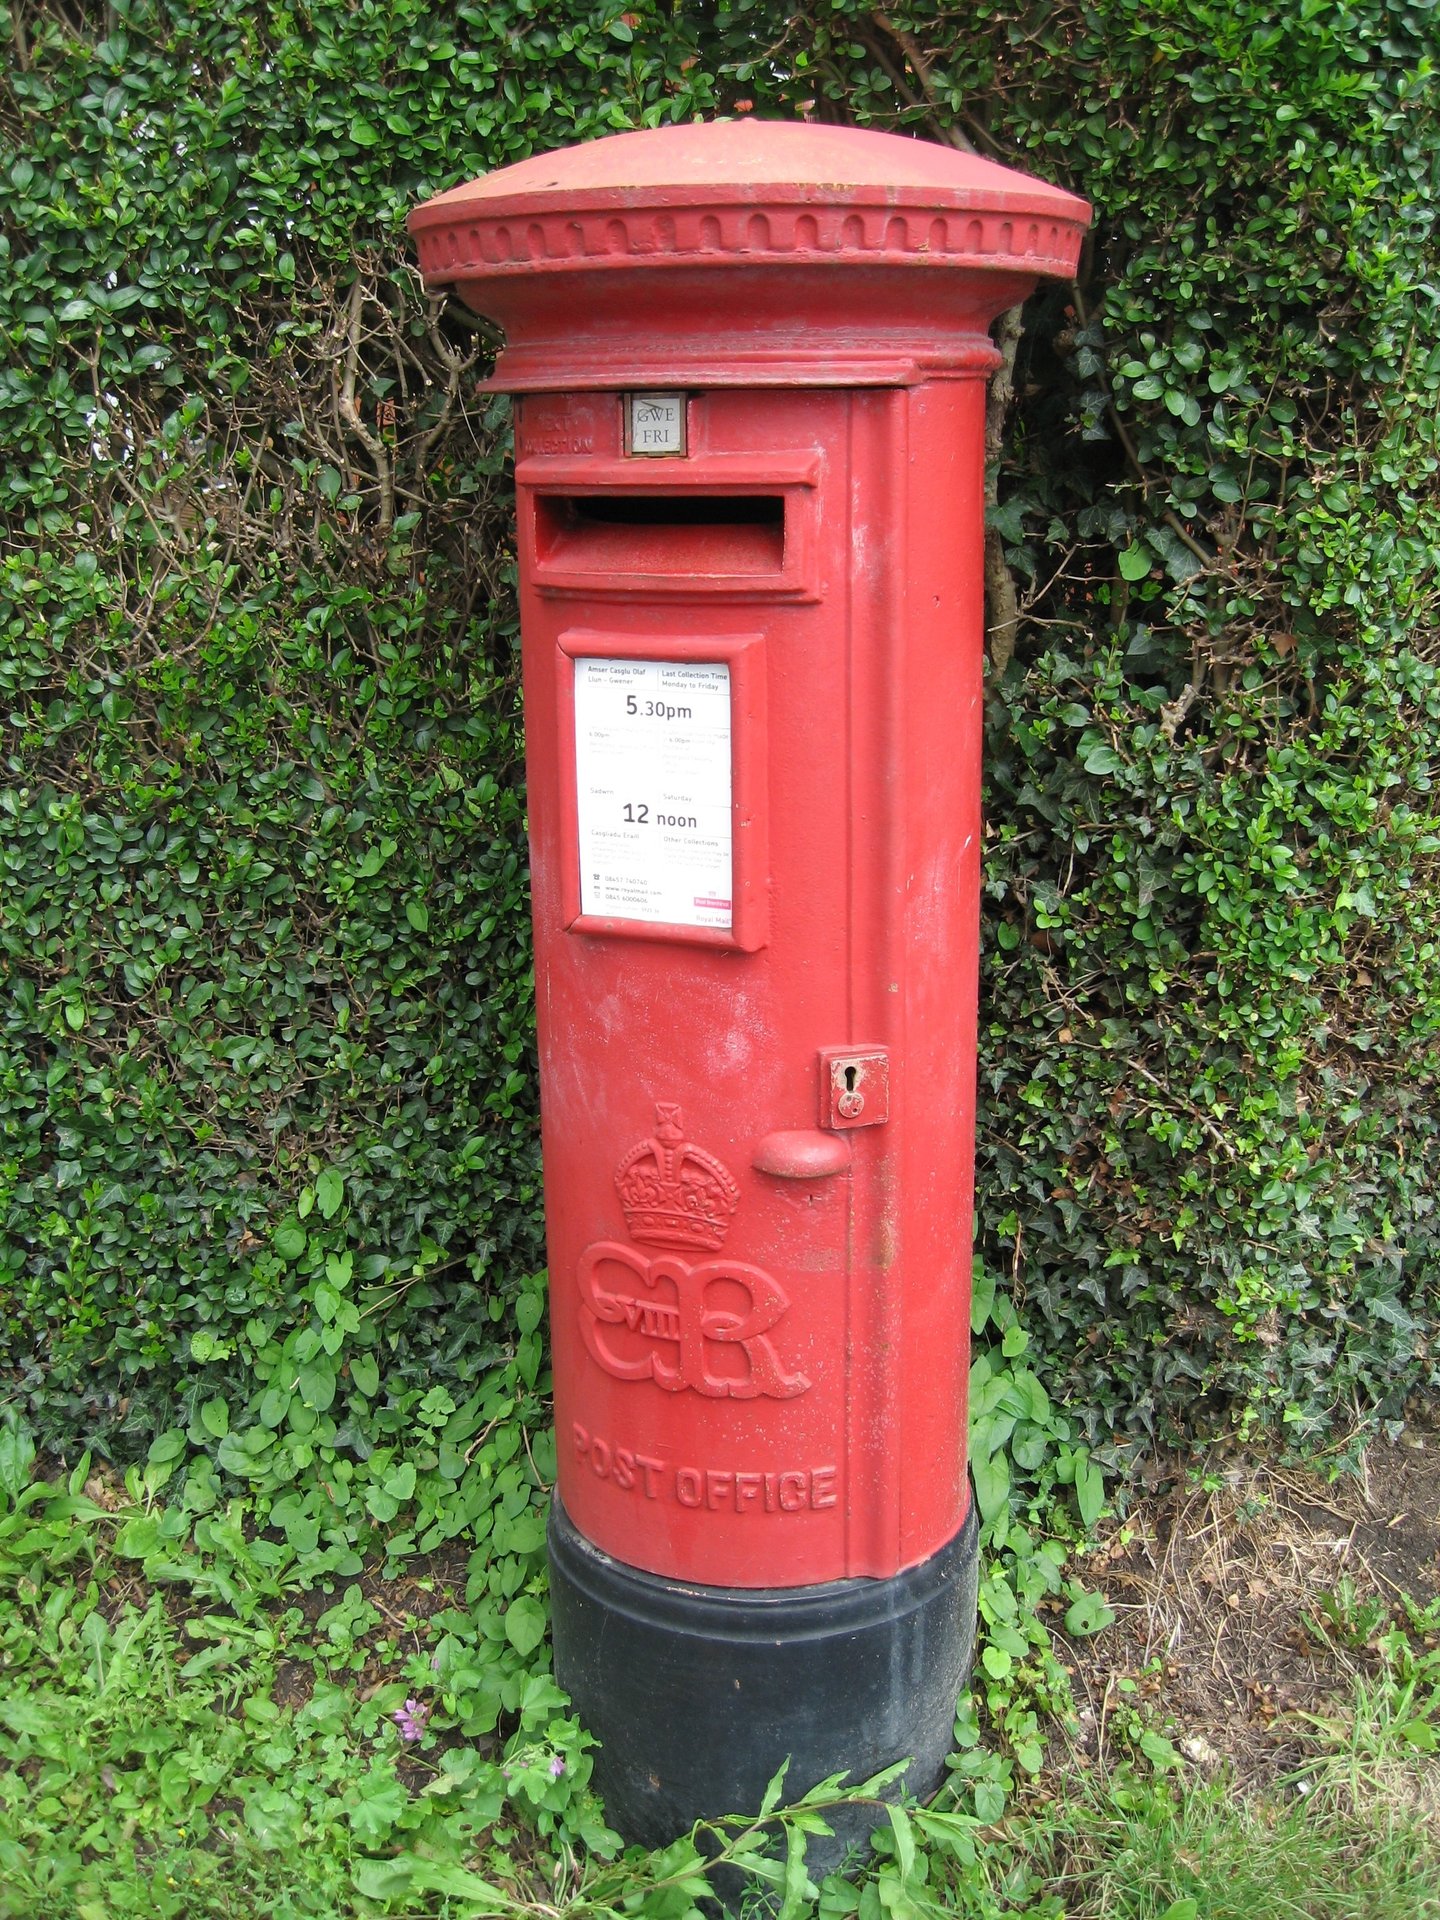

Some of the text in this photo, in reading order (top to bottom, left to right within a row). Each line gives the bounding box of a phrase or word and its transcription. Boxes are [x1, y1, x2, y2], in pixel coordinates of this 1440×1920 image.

[638, 407, 675, 422] GWE
[643, 429, 669, 443] FRI
[610, 667, 630, 676] Casglu
[662, 670, 728, 680] Last Collection Time
[609, 677, 633, 685] Gwener
[662, 681, 688, 689] Monday
[698, 683, 719, 691] Friday
[626, 694, 692, 721] 5.30pm
[590, 787, 614, 795] Sadwrn
[663, 793, 692, 802] Saturday
[622, 802, 697, 828] 12 noon
[663, 836, 719, 847] Other Collections
[572, 1421, 838, 1513] POST OFFICE
